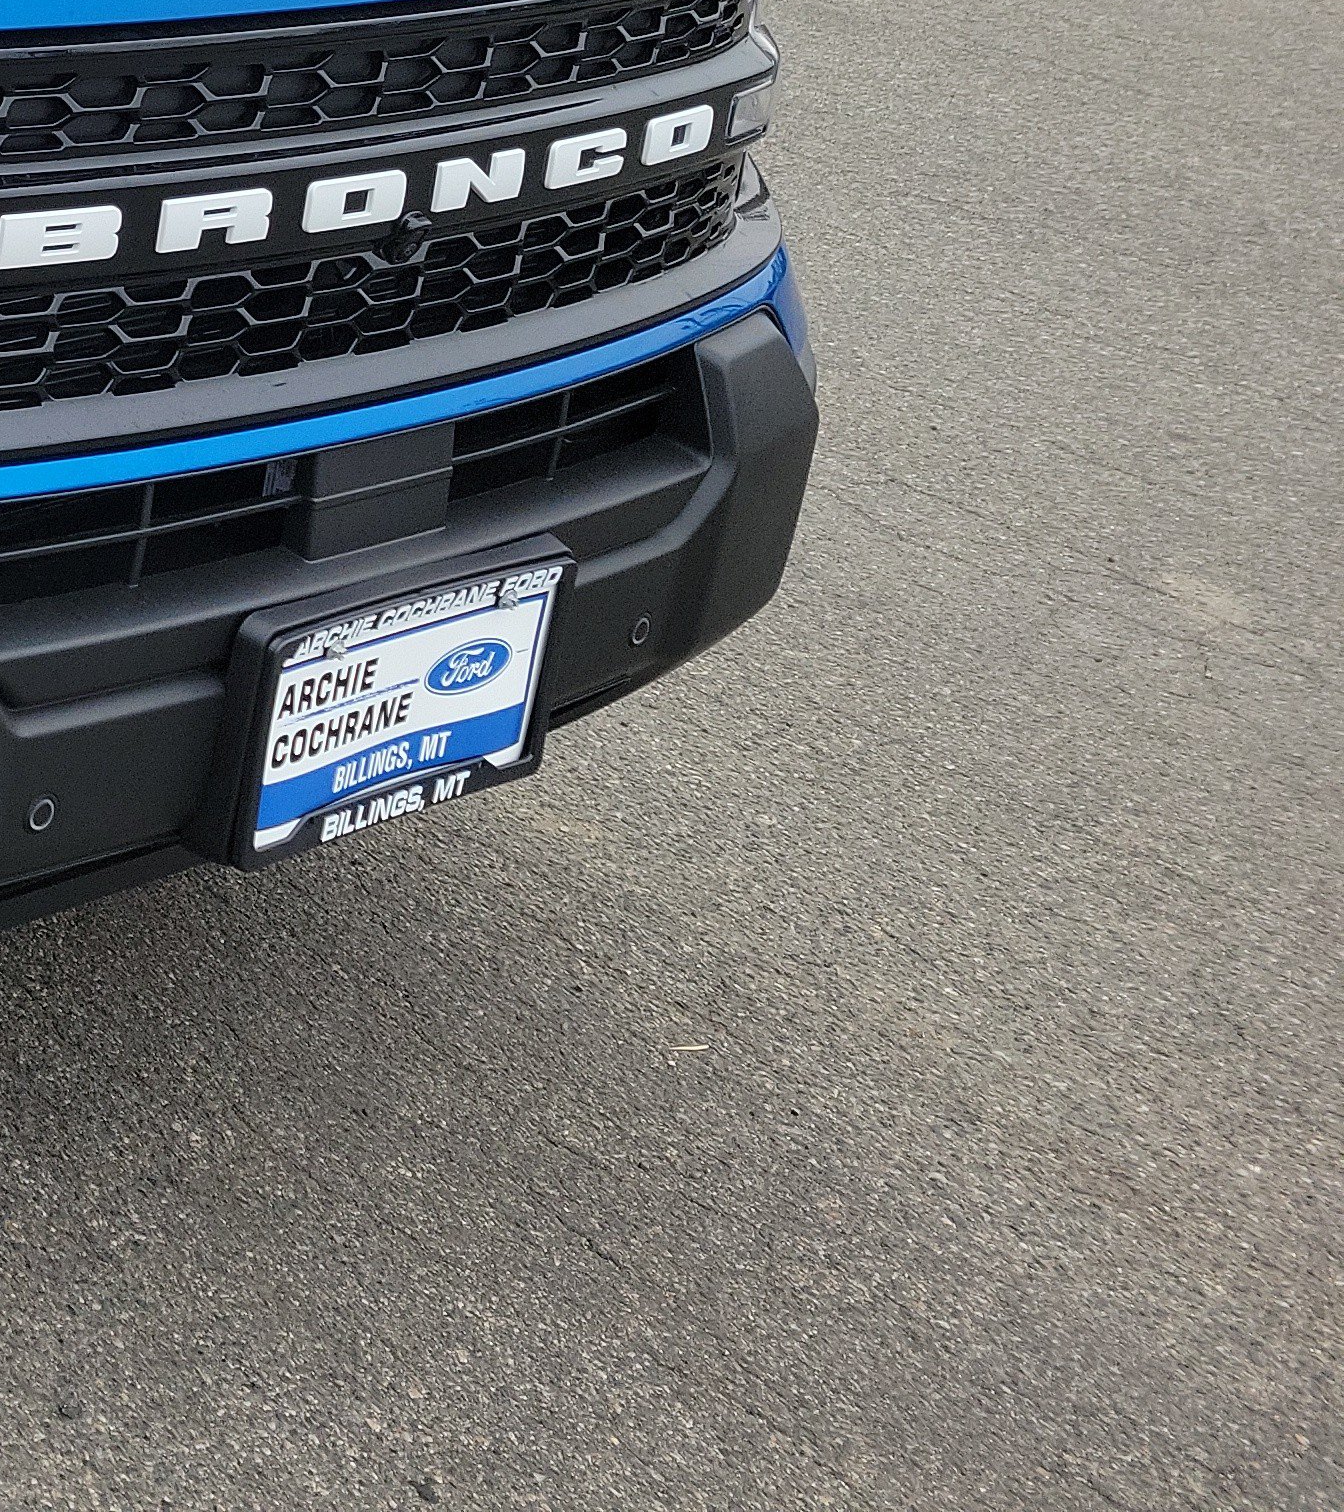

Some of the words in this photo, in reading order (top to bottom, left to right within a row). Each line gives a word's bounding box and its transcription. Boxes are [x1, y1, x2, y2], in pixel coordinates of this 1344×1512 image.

[295, 615, 377, 658] ARCHIE
[377, 581, 500, 630] COCHRANE
[499, 566, 563, 596] FORD
[277, 657, 379, 720] ARCHIE
[439, 647, 492, 687] Ford
[271, 692, 413, 769] COCHRANE
[332, 740, 413, 794] BILLINGS,
[418, 731, 451, 762] MT
[320, 786, 426, 843] BILLINGS,
[431, 771, 472, 805] MT
